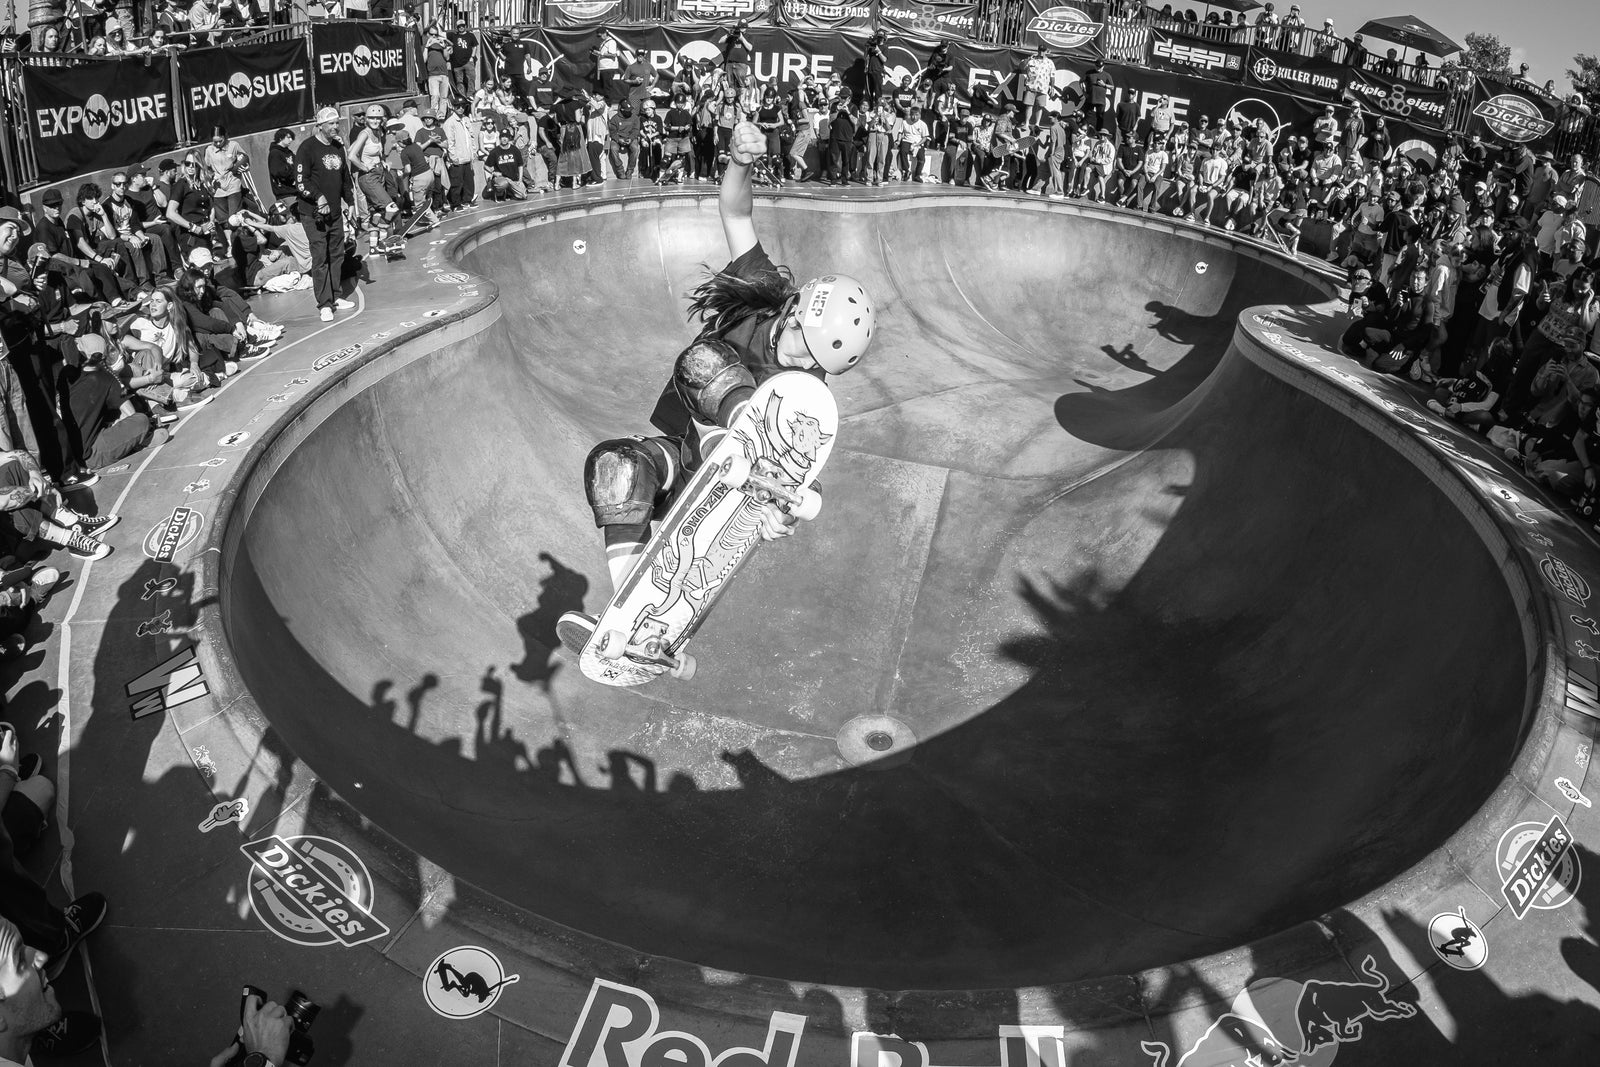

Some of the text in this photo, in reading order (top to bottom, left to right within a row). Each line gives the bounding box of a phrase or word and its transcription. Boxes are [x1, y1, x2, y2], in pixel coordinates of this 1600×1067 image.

[809, 4, 842, 17] KILLER
[844, 6, 870, 18] PADS
[881, 6, 974, 26] triple eight
[1034, 20, 1096, 36] Dickies
[1277, 66, 1310, 84] KILLER
[1311, 73, 1339, 90] PADS
[1349, 79, 1387, 98] triple
[1406, 96, 1445, 115] eight
[1481, 105, 1546, 132] Dickies
[681, 482, 729, 537] MIZUHO
[158, 511, 188, 559] Dickies
[1510, 828, 1567, 907] Dickies
[254, 844, 365, 937] Dickies
